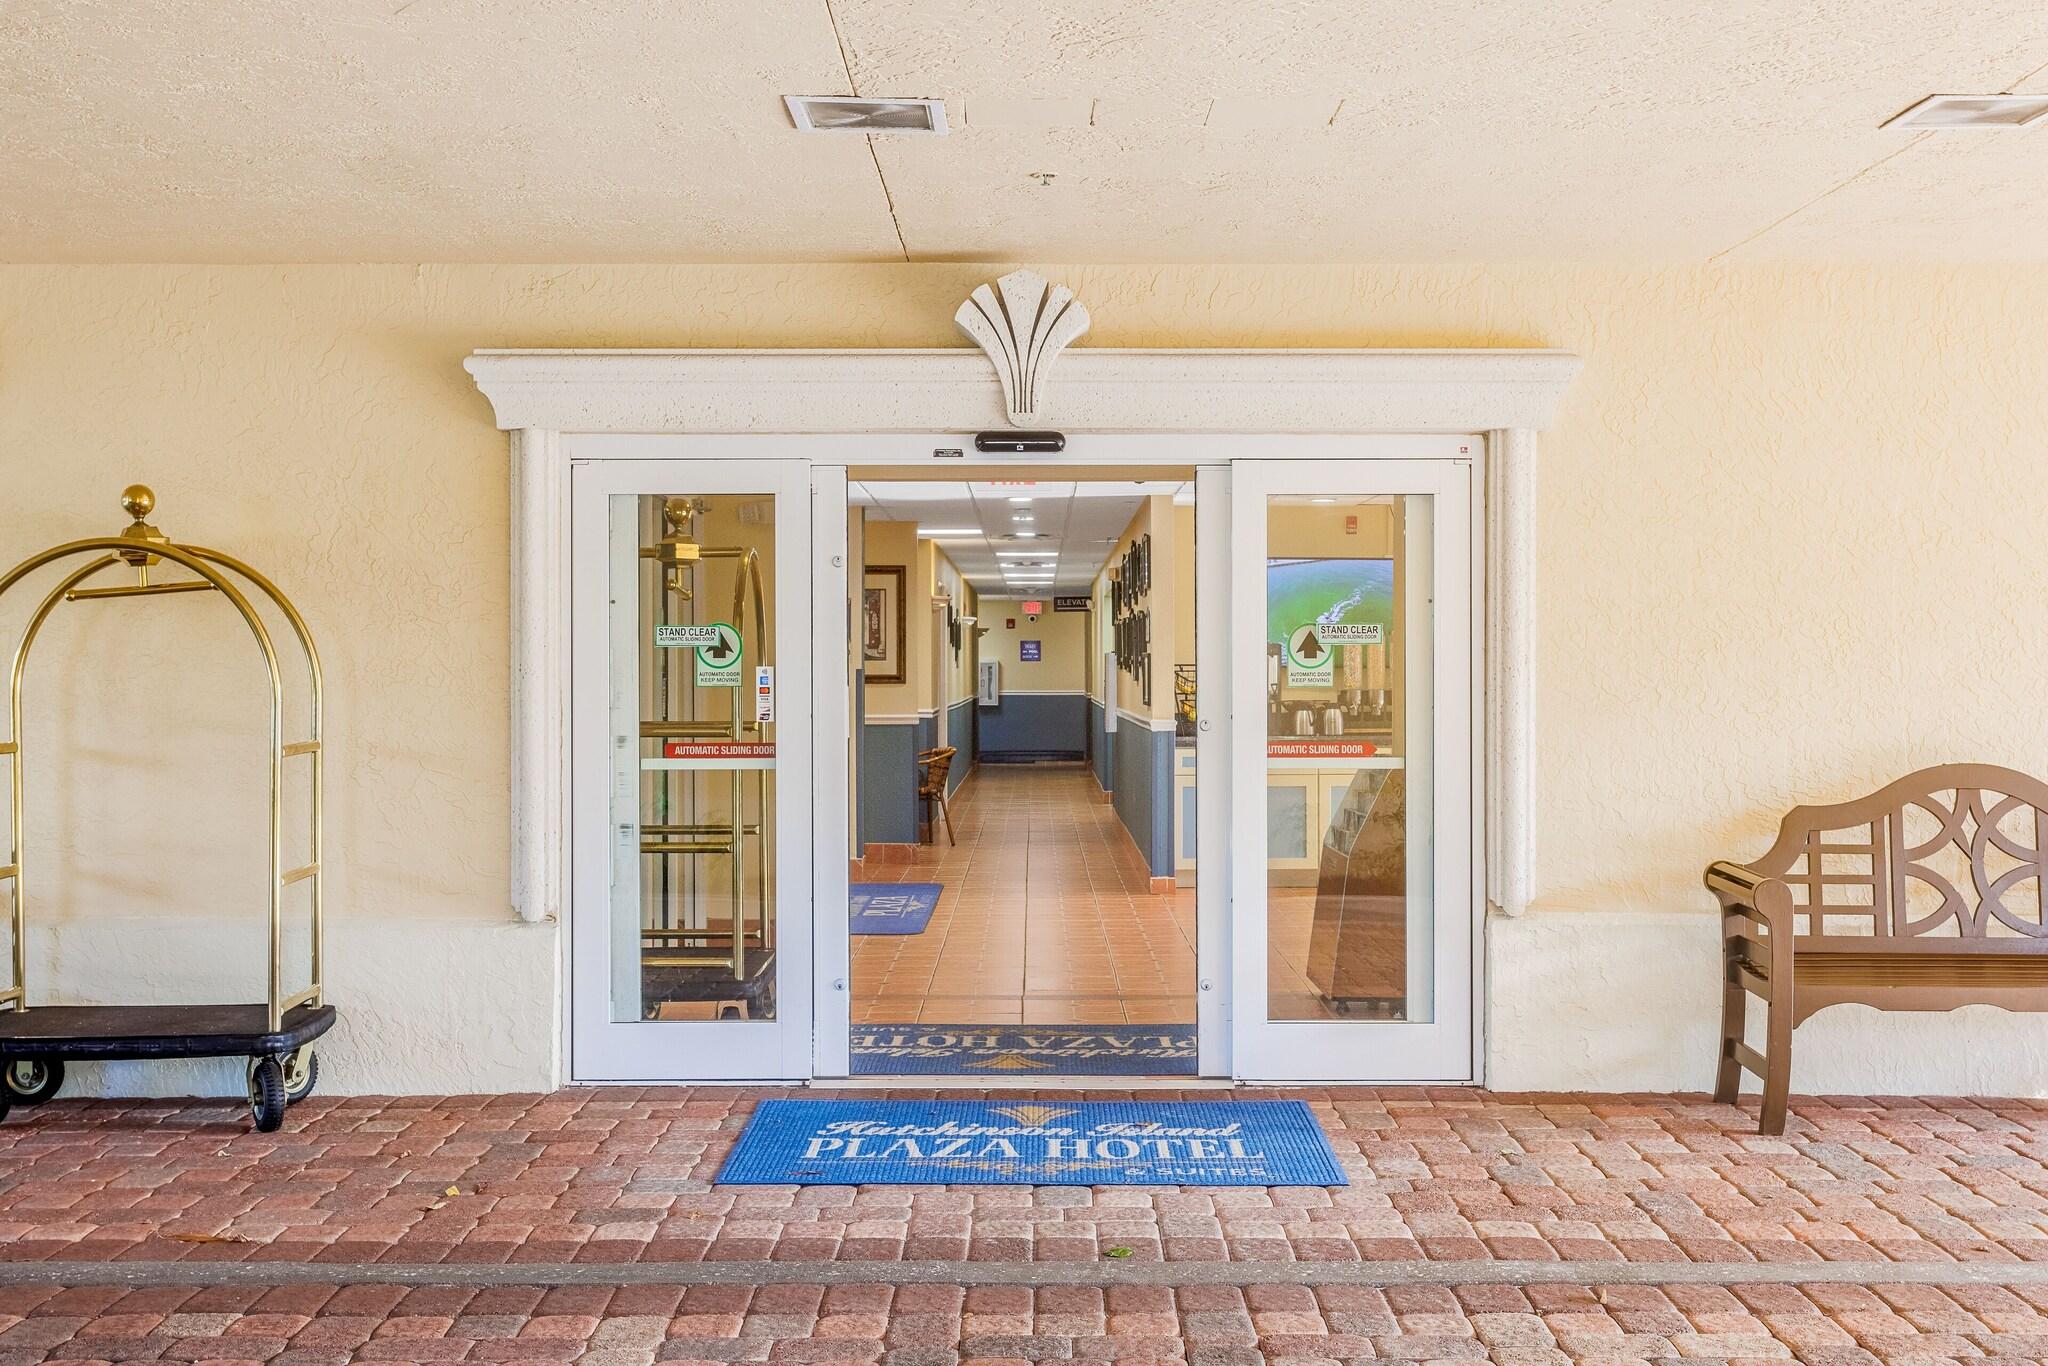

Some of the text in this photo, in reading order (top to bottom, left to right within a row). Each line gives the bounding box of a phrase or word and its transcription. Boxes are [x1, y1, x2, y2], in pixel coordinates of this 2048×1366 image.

[658, 628, 716, 636] STAND CLEAR
[1320, 626, 1379, 634] STAND CLEAR
[674, 745, 774, 755] AUTOMATIC SLIDING DOOR
[1267, 745, 1363, 754] UTOMATIC SLIDING DOOR
[851, 1035, 1001, 1047] HOTE
[816, 1120, 1242, 1137] Hutchinson Island
[800, 1137, 1265, 1159] PLAZA HOTEL
[1156, 1167, 1266, 1176] SUITES
